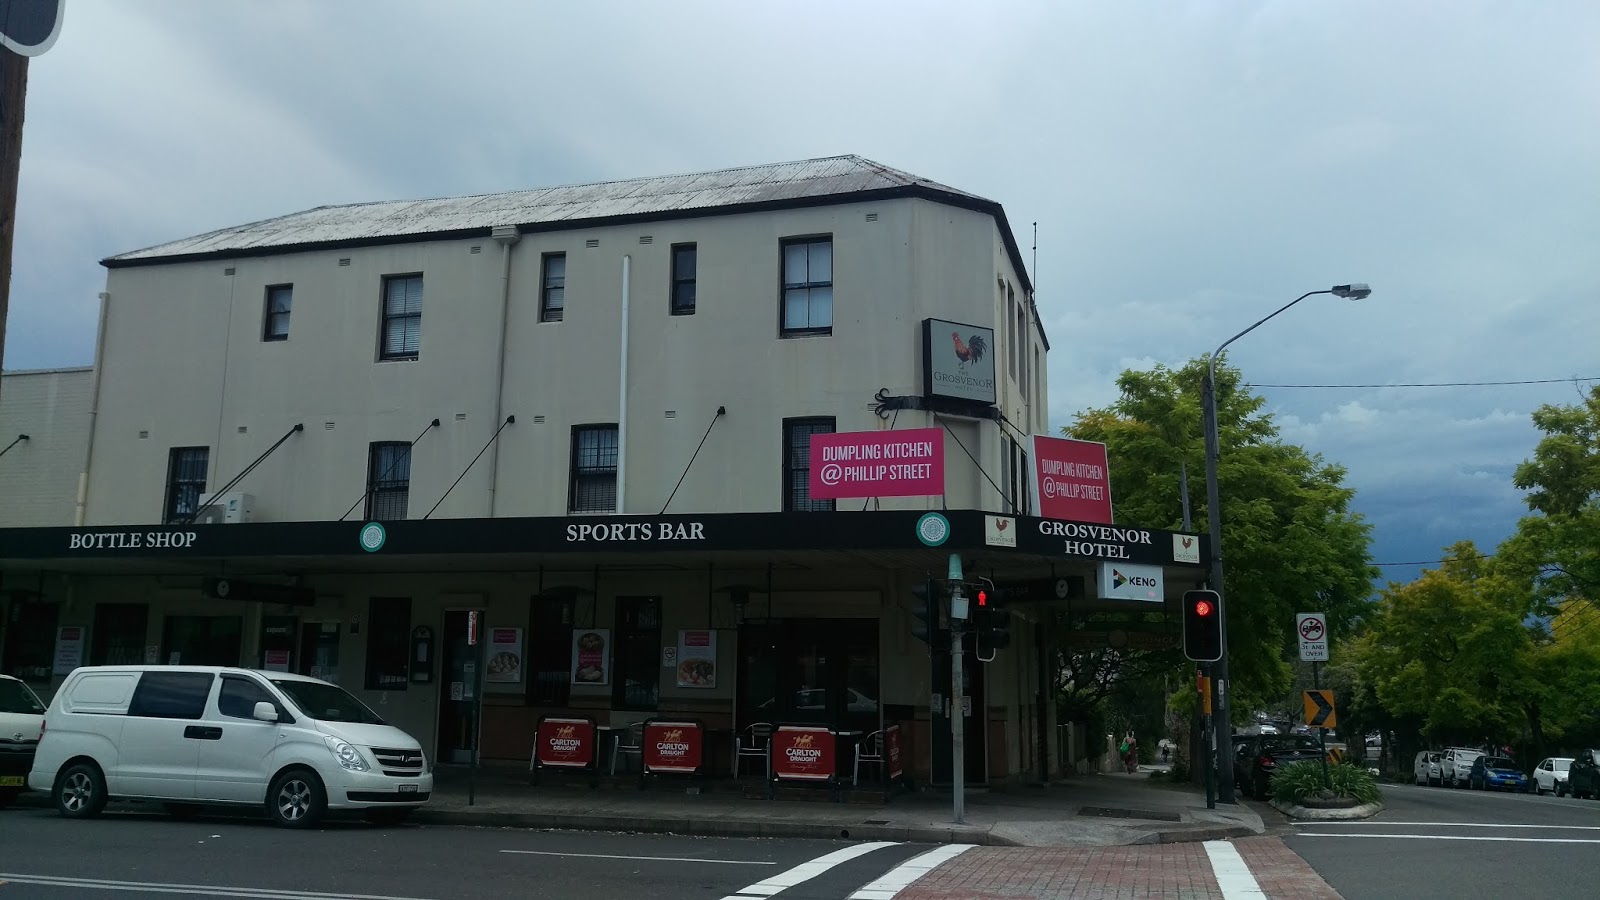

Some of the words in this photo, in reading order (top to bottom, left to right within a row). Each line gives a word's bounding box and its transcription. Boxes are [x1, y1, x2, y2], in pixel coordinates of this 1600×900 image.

[933, 371, 993, 389] GROSVENOR
[822, 443, 881, 461] DUMPLING
[883, 441, 932, 459] KITCHEN
[820, 463, 842, 486] @
[844, 465, 887, 482] PHILLIP
[889, 463, 932, 480] STREET
[1041, 458, 1075, 477] DUMPLING
[1075, 463, 1103, 480] KITCHEN
[1042, 476, 1056, 499] @
[1056, 481, 1080, 498] PHILLIP
[1080, 484, 1104, 501] STREET
[69, 533, 142, 549] BOTTLE
[146, 531, 197, 548] SHOP
[566, 522, 653, 542] SPORTS
[658, 522, 706, 540] BAR
[1038, 520, 1152, 545] GROSVENOR
[1064, 540, 1130, 559] HOTEL
[1129, 576, 1156, 587] KENO
[549, 738, 581, 746] CARLTON
[656, 742, 689, 750] CARLTON
[786, 748, 821, 757] CARLTON
